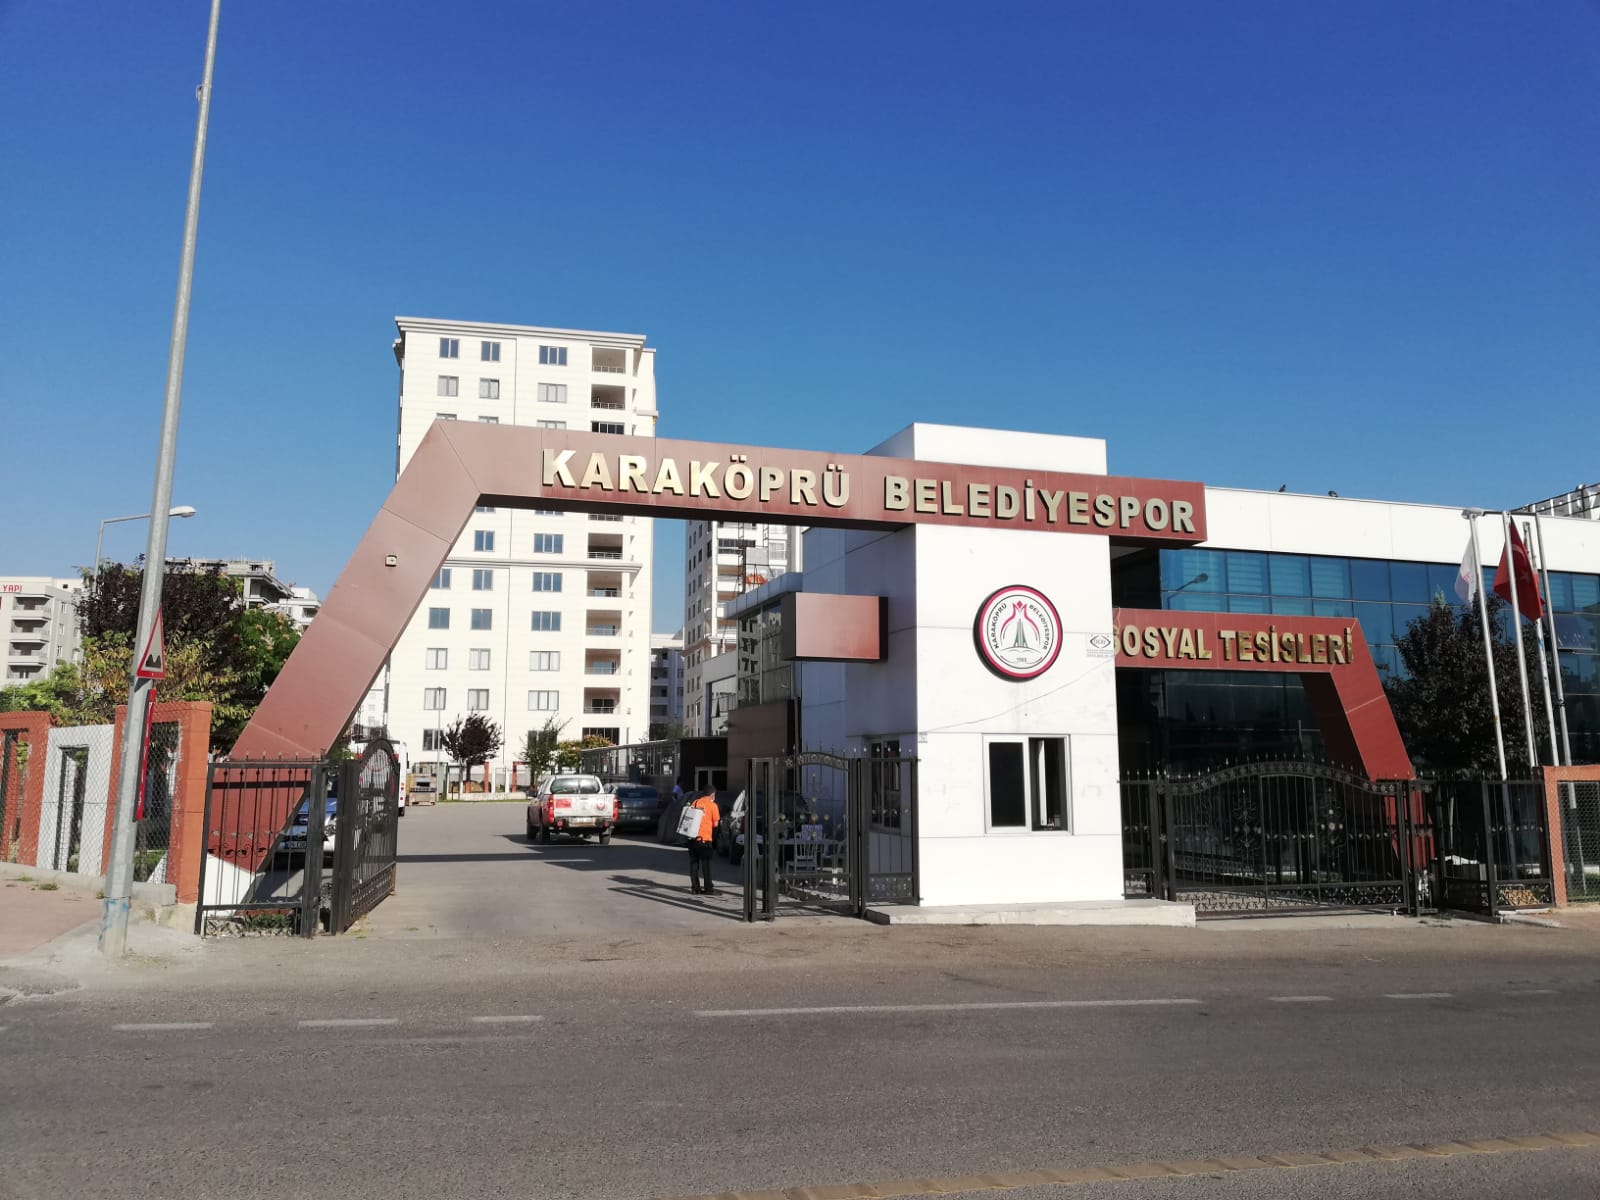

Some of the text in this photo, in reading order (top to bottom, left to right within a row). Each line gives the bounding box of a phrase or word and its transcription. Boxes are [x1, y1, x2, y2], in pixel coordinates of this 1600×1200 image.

[541, 448, 1196, 533] KARAKÖPRÜ BELEDİYESPOR
[1218, 625, 1354, 664] TESİSLERİ
